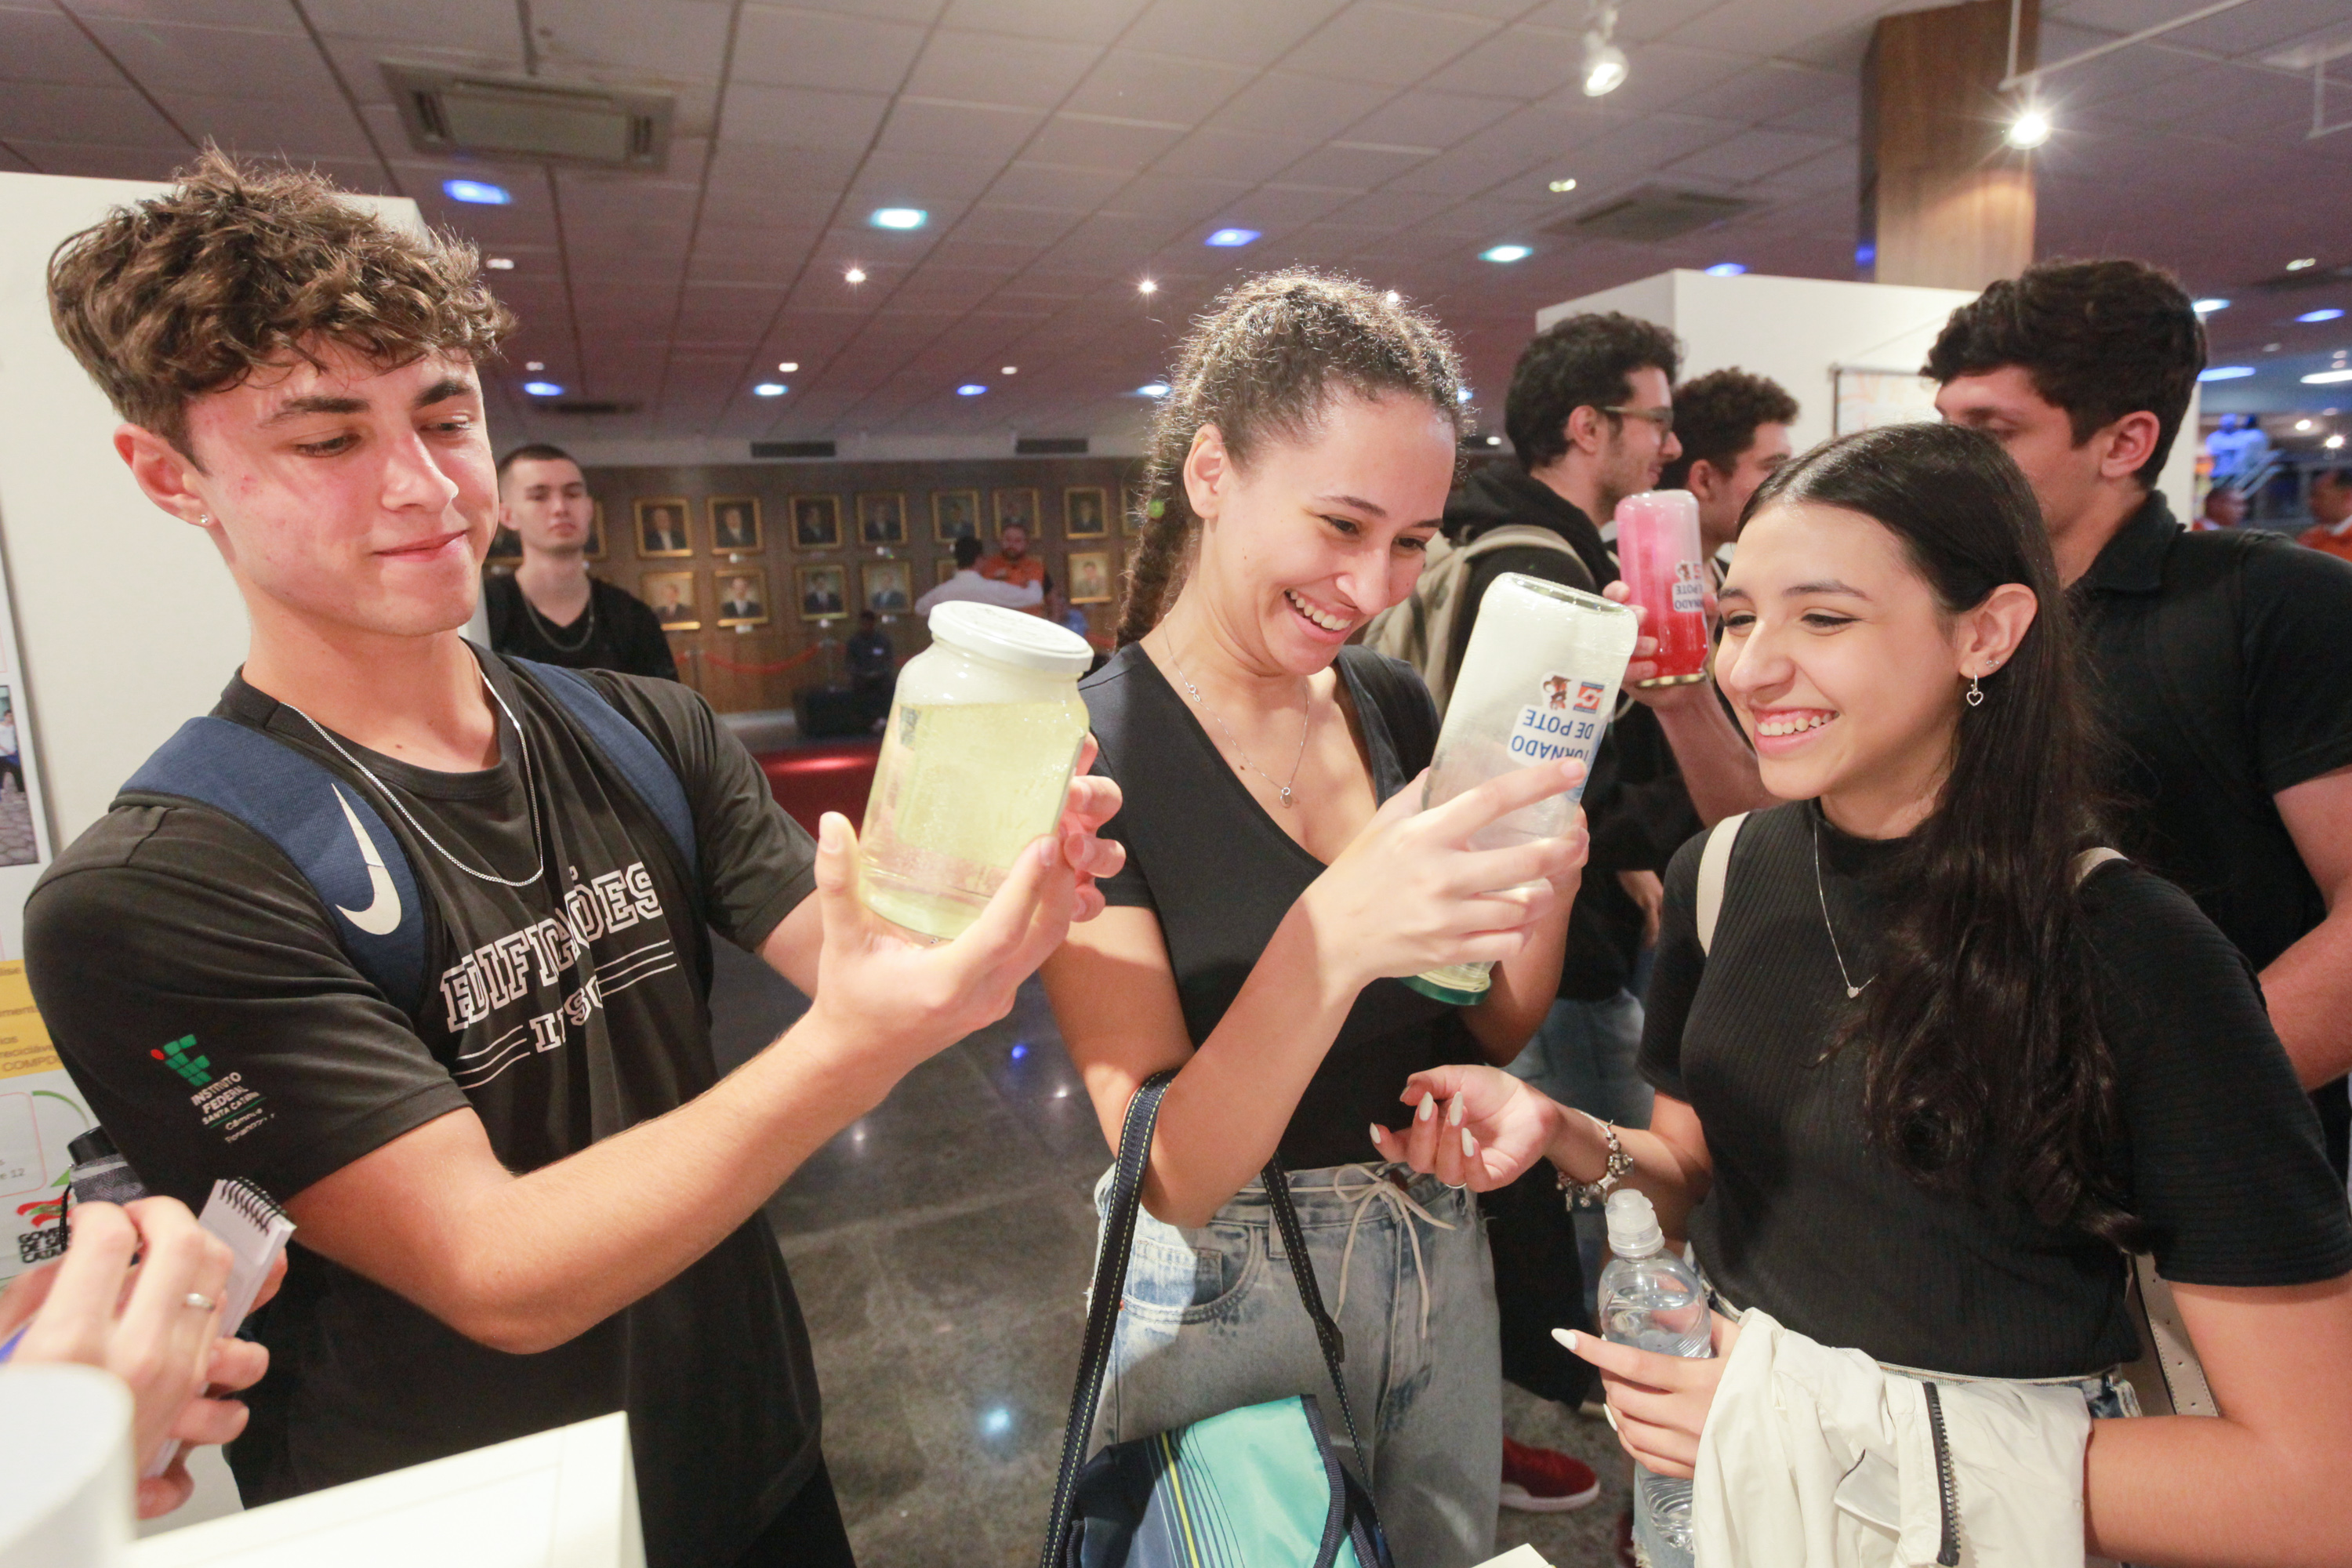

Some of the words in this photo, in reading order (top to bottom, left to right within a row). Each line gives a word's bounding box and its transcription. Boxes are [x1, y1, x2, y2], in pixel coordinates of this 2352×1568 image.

[1523, 709, 1573, 736] POTE
[1575, 722, 1595, 739] DE
[190, 1072, 242, 1106] INSTITUTO
[201, 1085, 249, 1114] FEDERAL
[201, 1107, 230, 1125] SANTA
